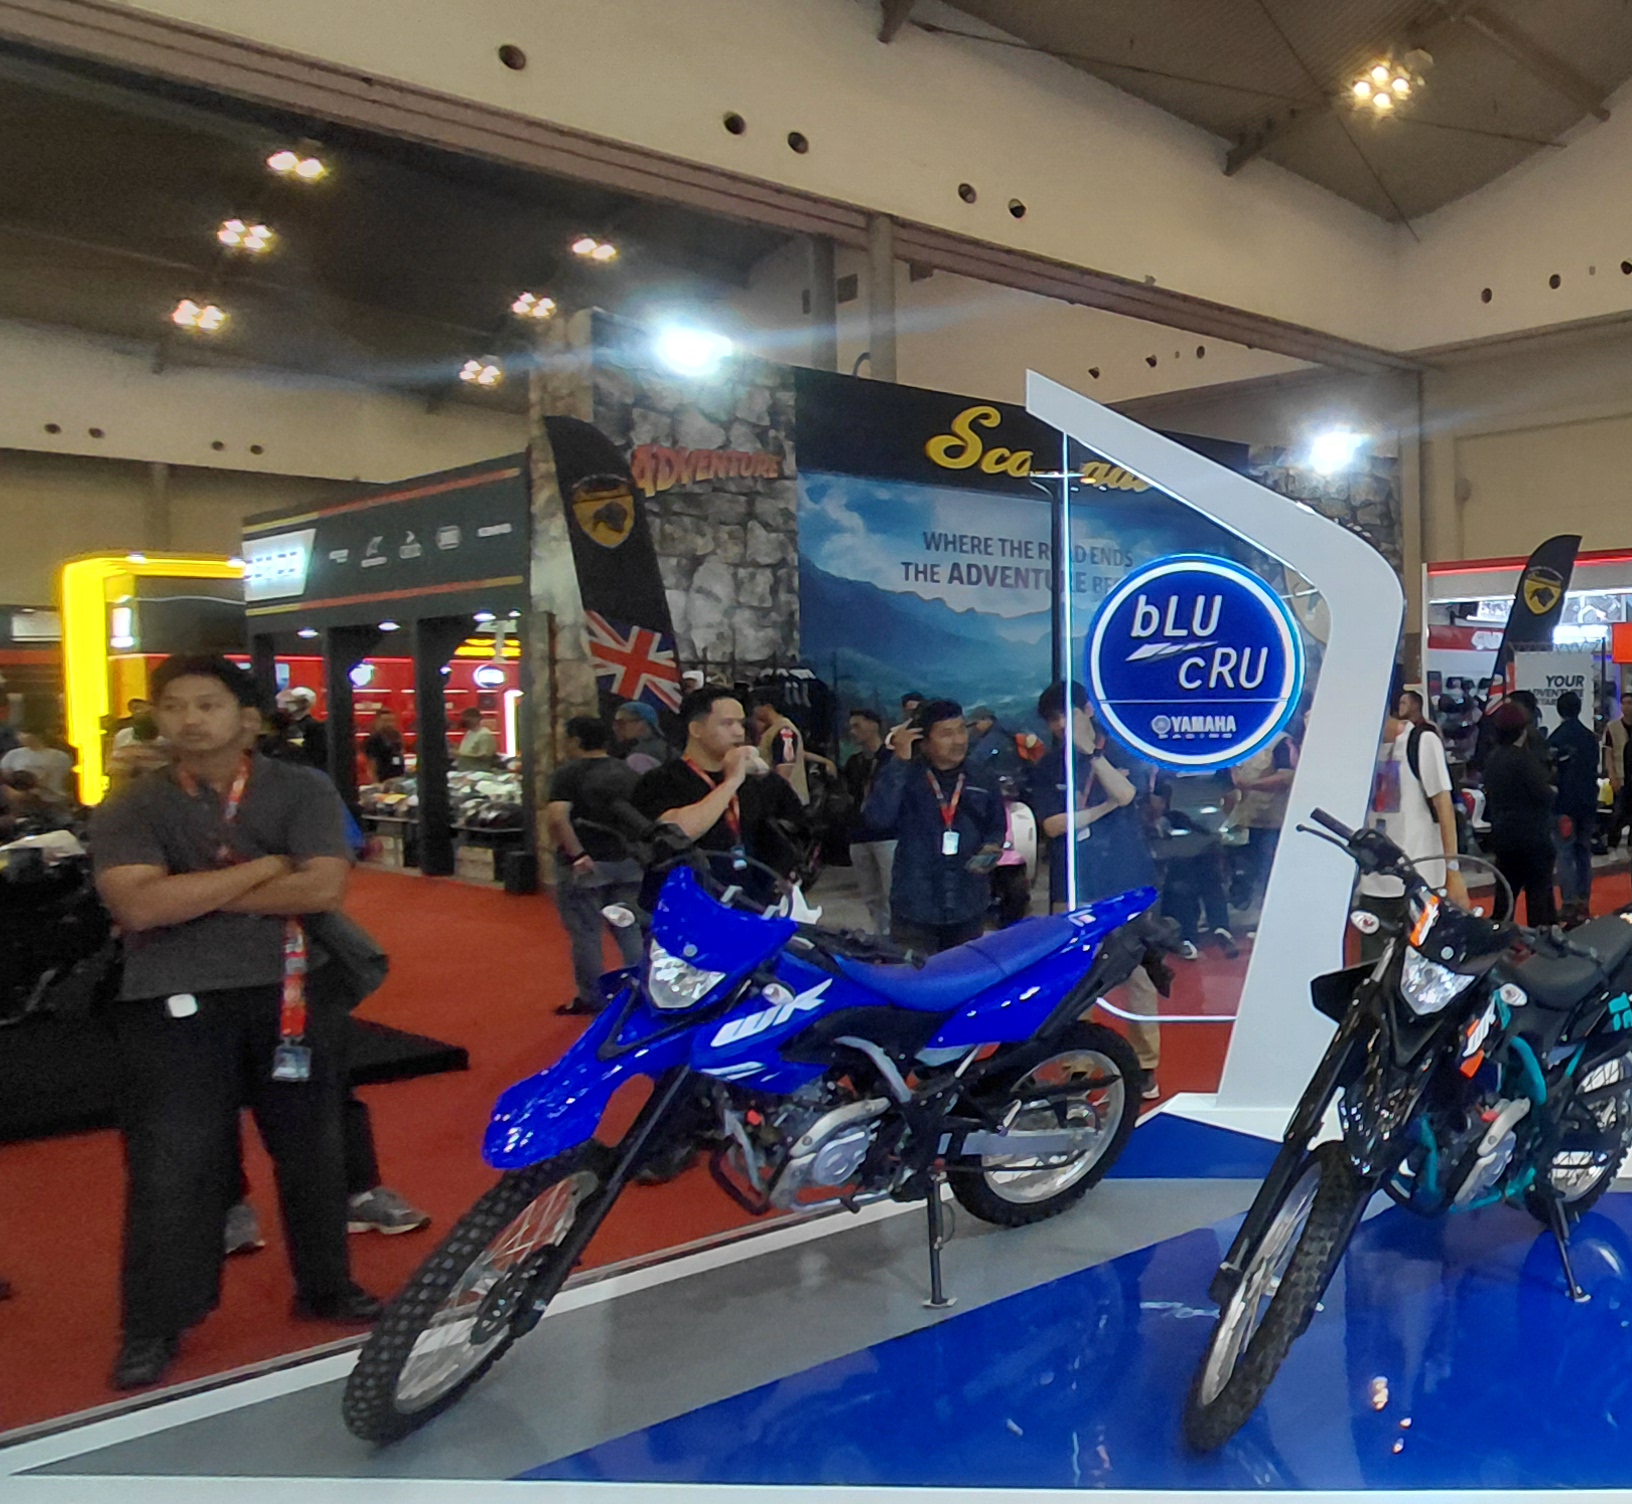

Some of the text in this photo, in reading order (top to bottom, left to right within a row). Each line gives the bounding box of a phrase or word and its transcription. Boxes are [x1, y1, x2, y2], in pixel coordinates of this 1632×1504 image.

[631, 444, 784, 497] ADVENTURE
[923, 531, 994, 556] WHERE
[997, 538, 1035, 559] THE
[1090, 546, 1134, 568] ENDS
[901, 562, 941, 583] THE
[1130, 594, 1223, 639] bLU
[1178, 646, 1270, 690] cRU
[1545, 674, 1586, 688] YOUR
[1172, 715, 1237, 734] YAMAHA
